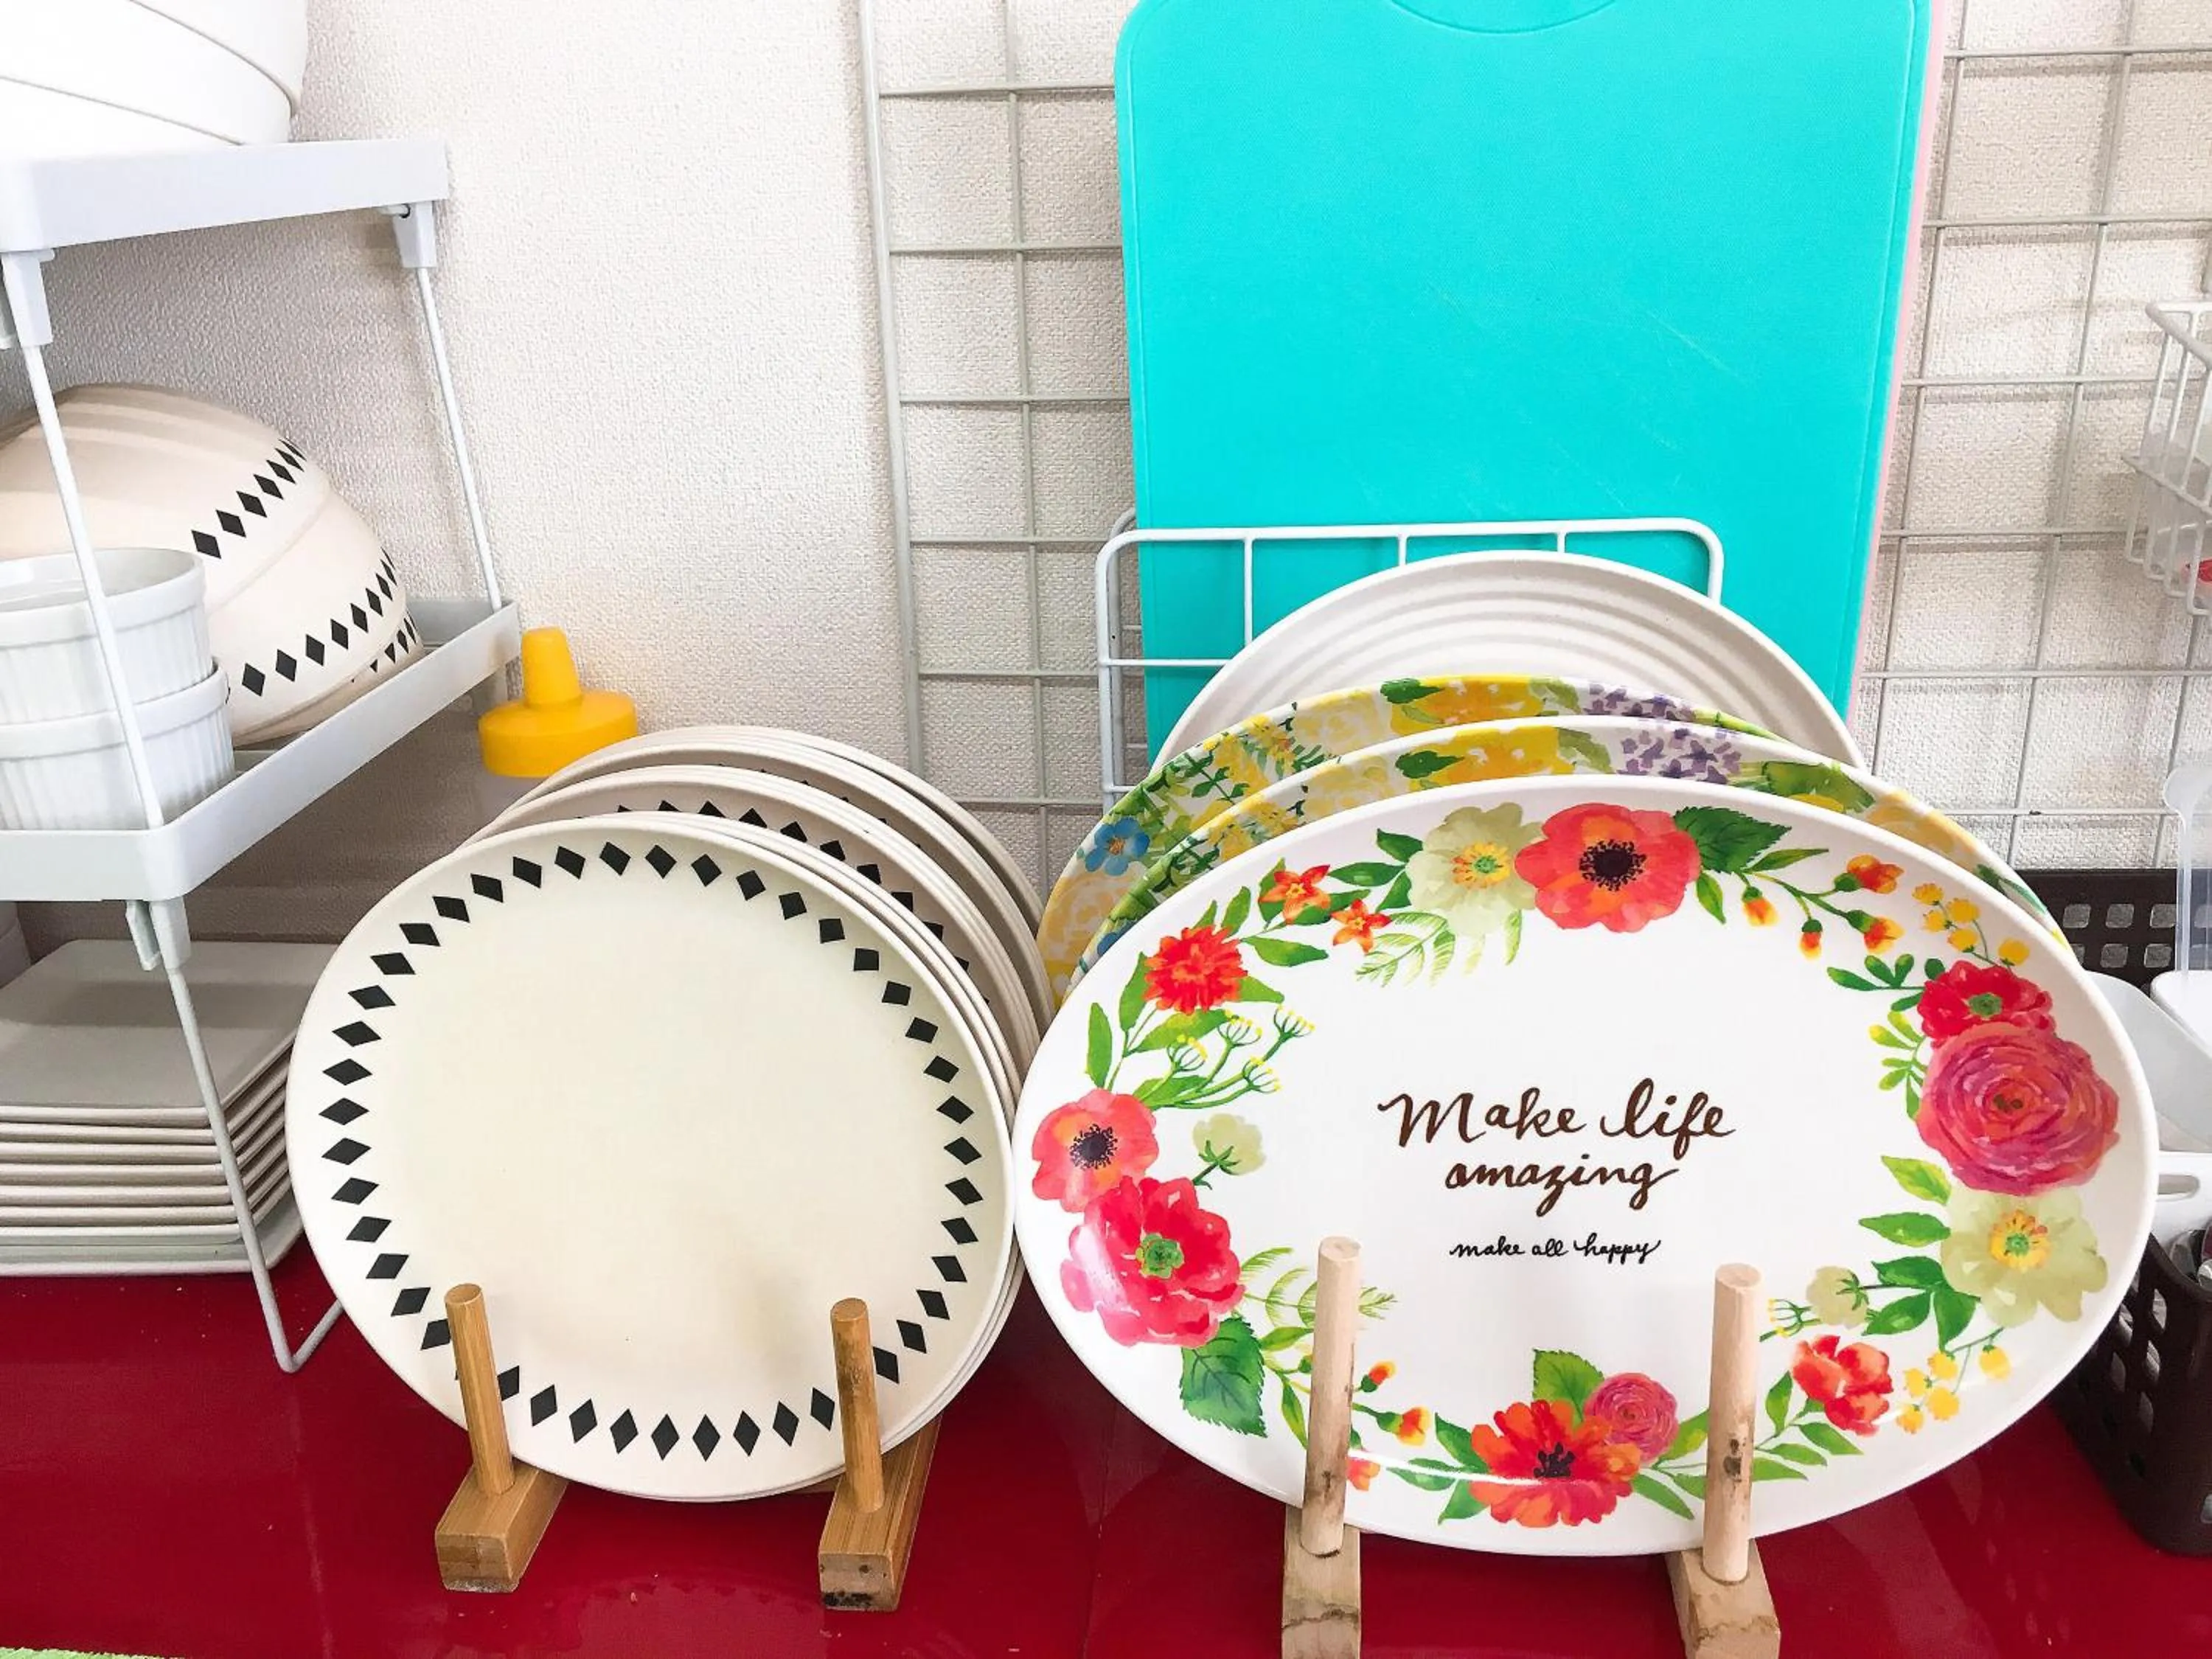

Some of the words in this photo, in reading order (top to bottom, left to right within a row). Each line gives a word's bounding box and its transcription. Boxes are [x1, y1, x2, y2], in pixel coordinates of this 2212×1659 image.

[1377, 1087, 1587, 1147] Make
[1599, 1077, 1736, 1161] life
[1444, 1153, 1680, 1217] amazing
[1449, 1235, 1526, 1258] make
[1531, 1238, 1569, 1258] all
[1573, 1232, 1661, 1265] happy
